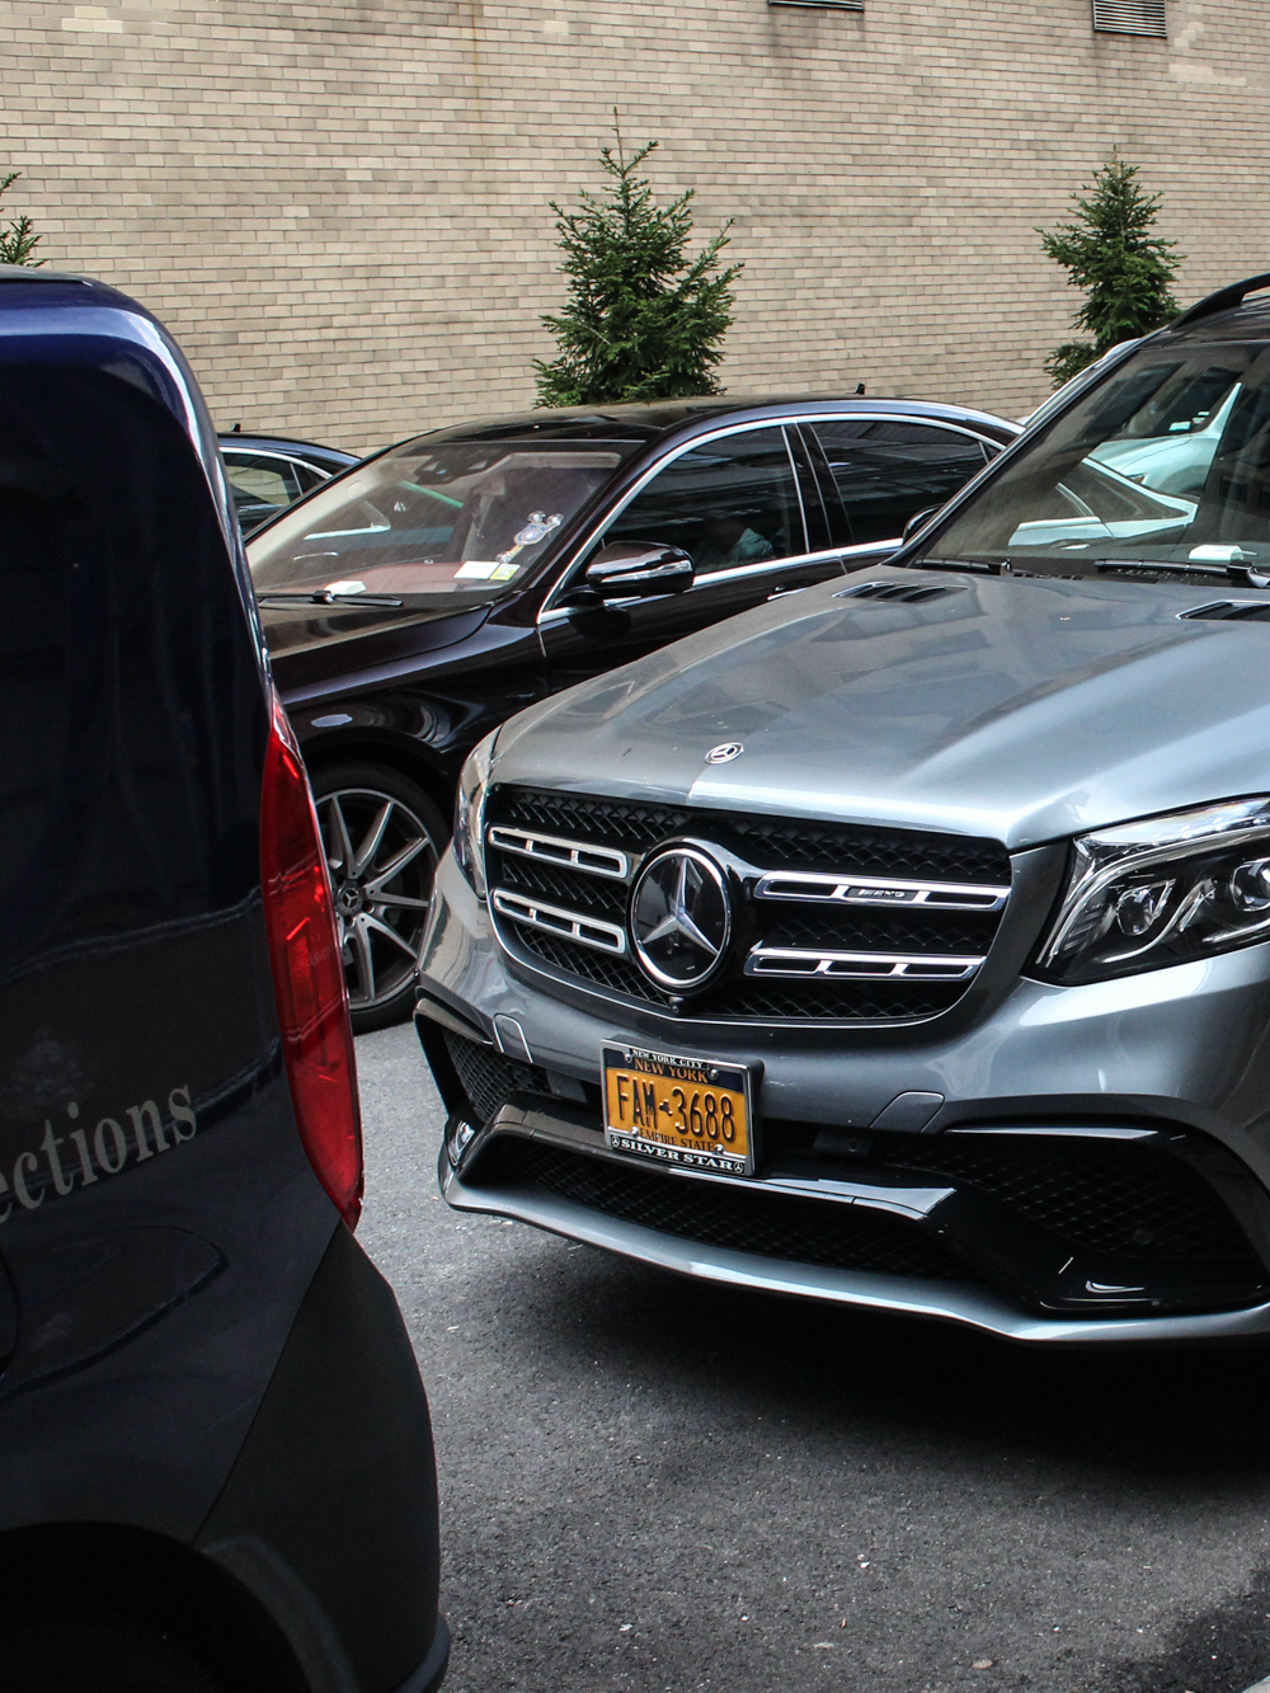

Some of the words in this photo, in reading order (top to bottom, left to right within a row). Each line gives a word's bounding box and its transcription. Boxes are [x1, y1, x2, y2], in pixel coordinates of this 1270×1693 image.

[633, 1049, 650, 1060] NEW
[652, 1054, 677, 1065] YORK
[679, 1058, 704, 1069] CITY
[634, 1058, 665, 1075] NEW
[669, 1067, 709, 1084] YORK
[639, 1129, 677, 1146] EMPIRE
[680, 1138, 715, 1152] STATE
[621, 1138, 680, 1161] SILVER
[683, 1151, 733, 1170] STAR
